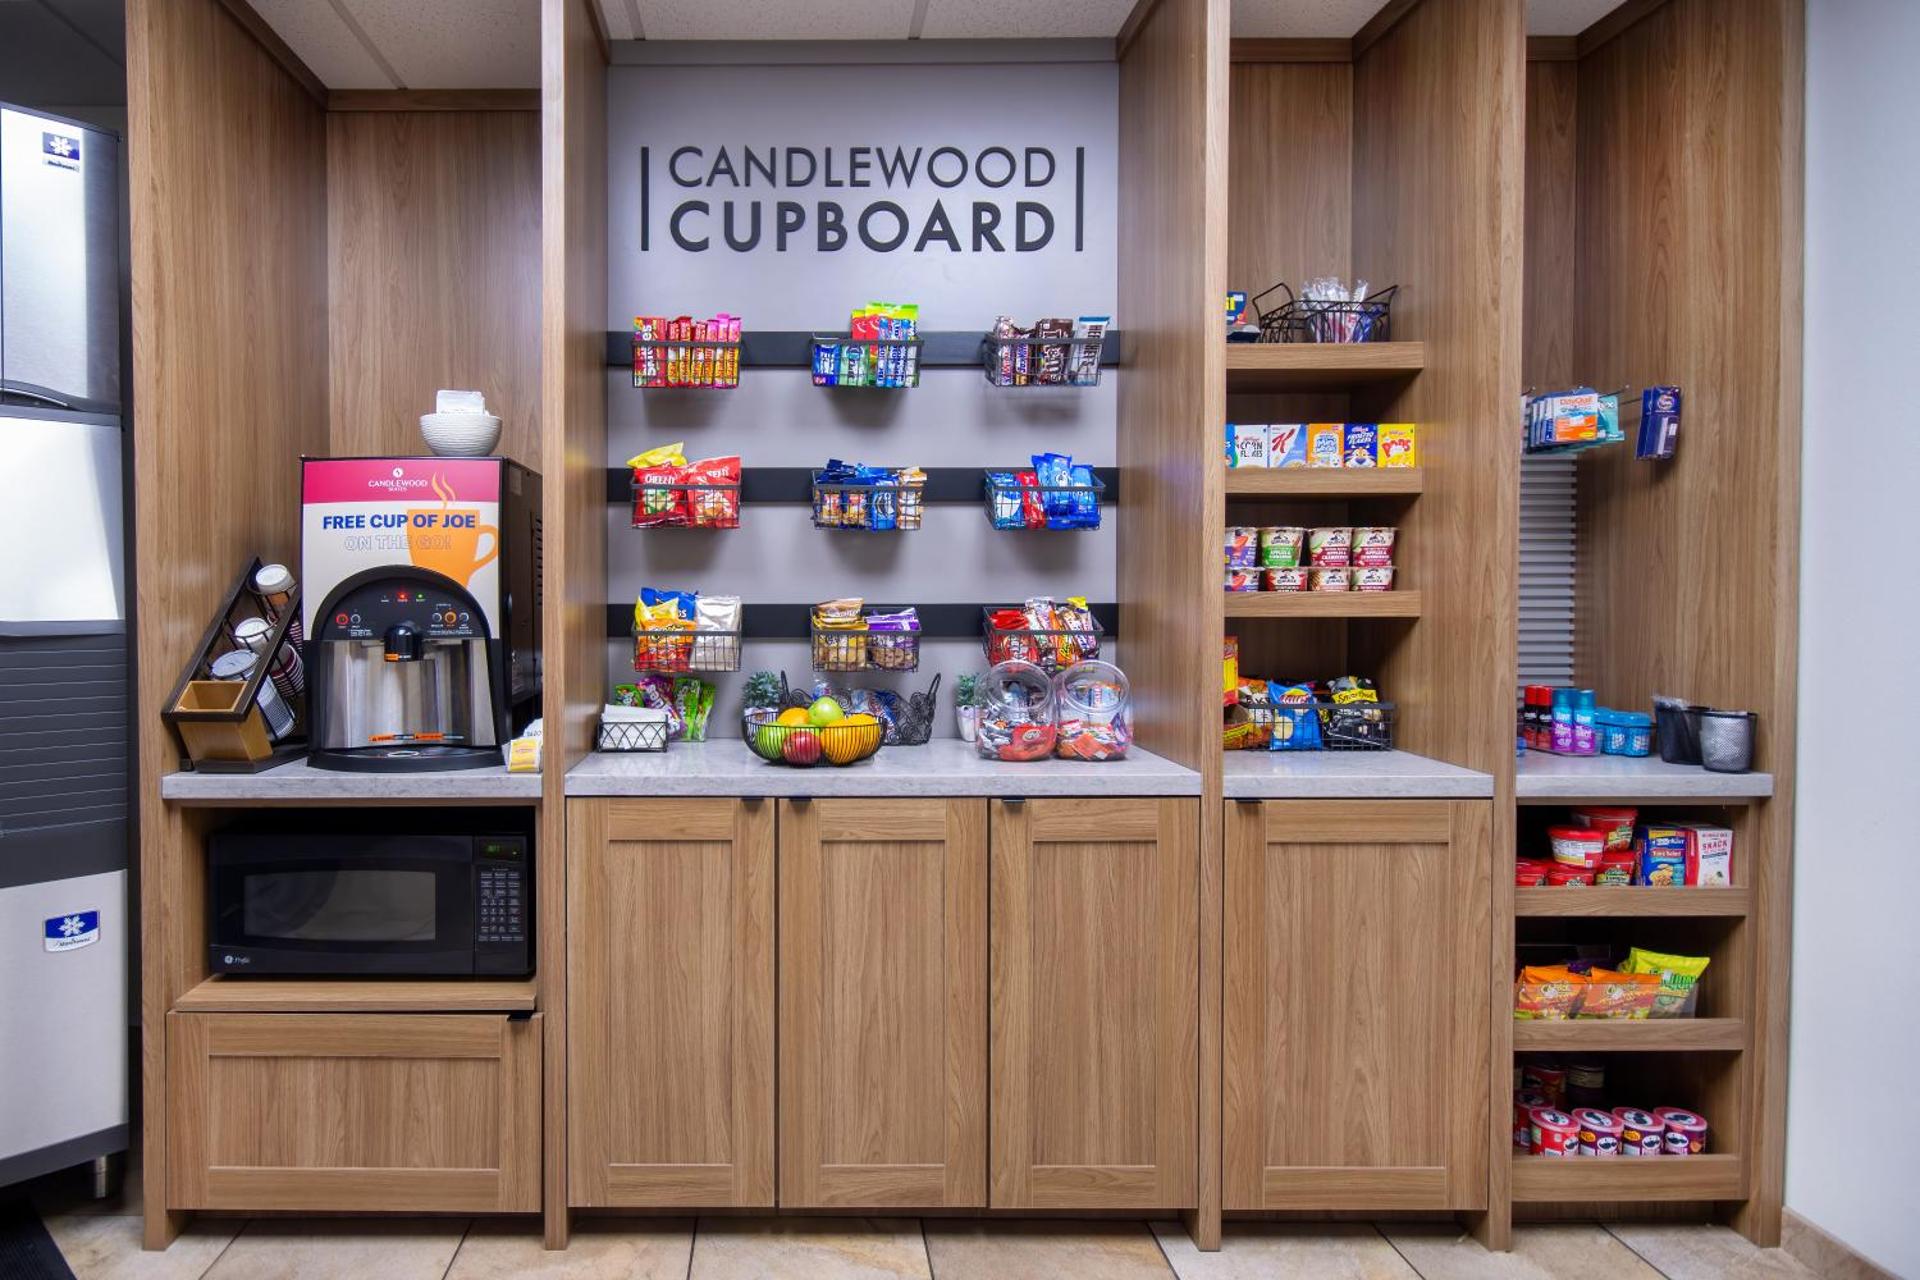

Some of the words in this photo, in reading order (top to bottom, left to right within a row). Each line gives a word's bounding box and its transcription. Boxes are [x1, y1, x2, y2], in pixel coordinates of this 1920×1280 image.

[669, 145, 1056, 188] CANDLEWOOD
[670, 198, 1055, 252] CUPBOARD
[368, 480, 428, 488] CANDLEWOOD
[323, 514, 366, 529] FREE
[369, 513, 409, 529] CUP
[412, 513, 439, 528] OF
[441, 514, 476, 529] JOE
[344, 535, 372, 551] ON
[374, 534, 410, 550] THE
